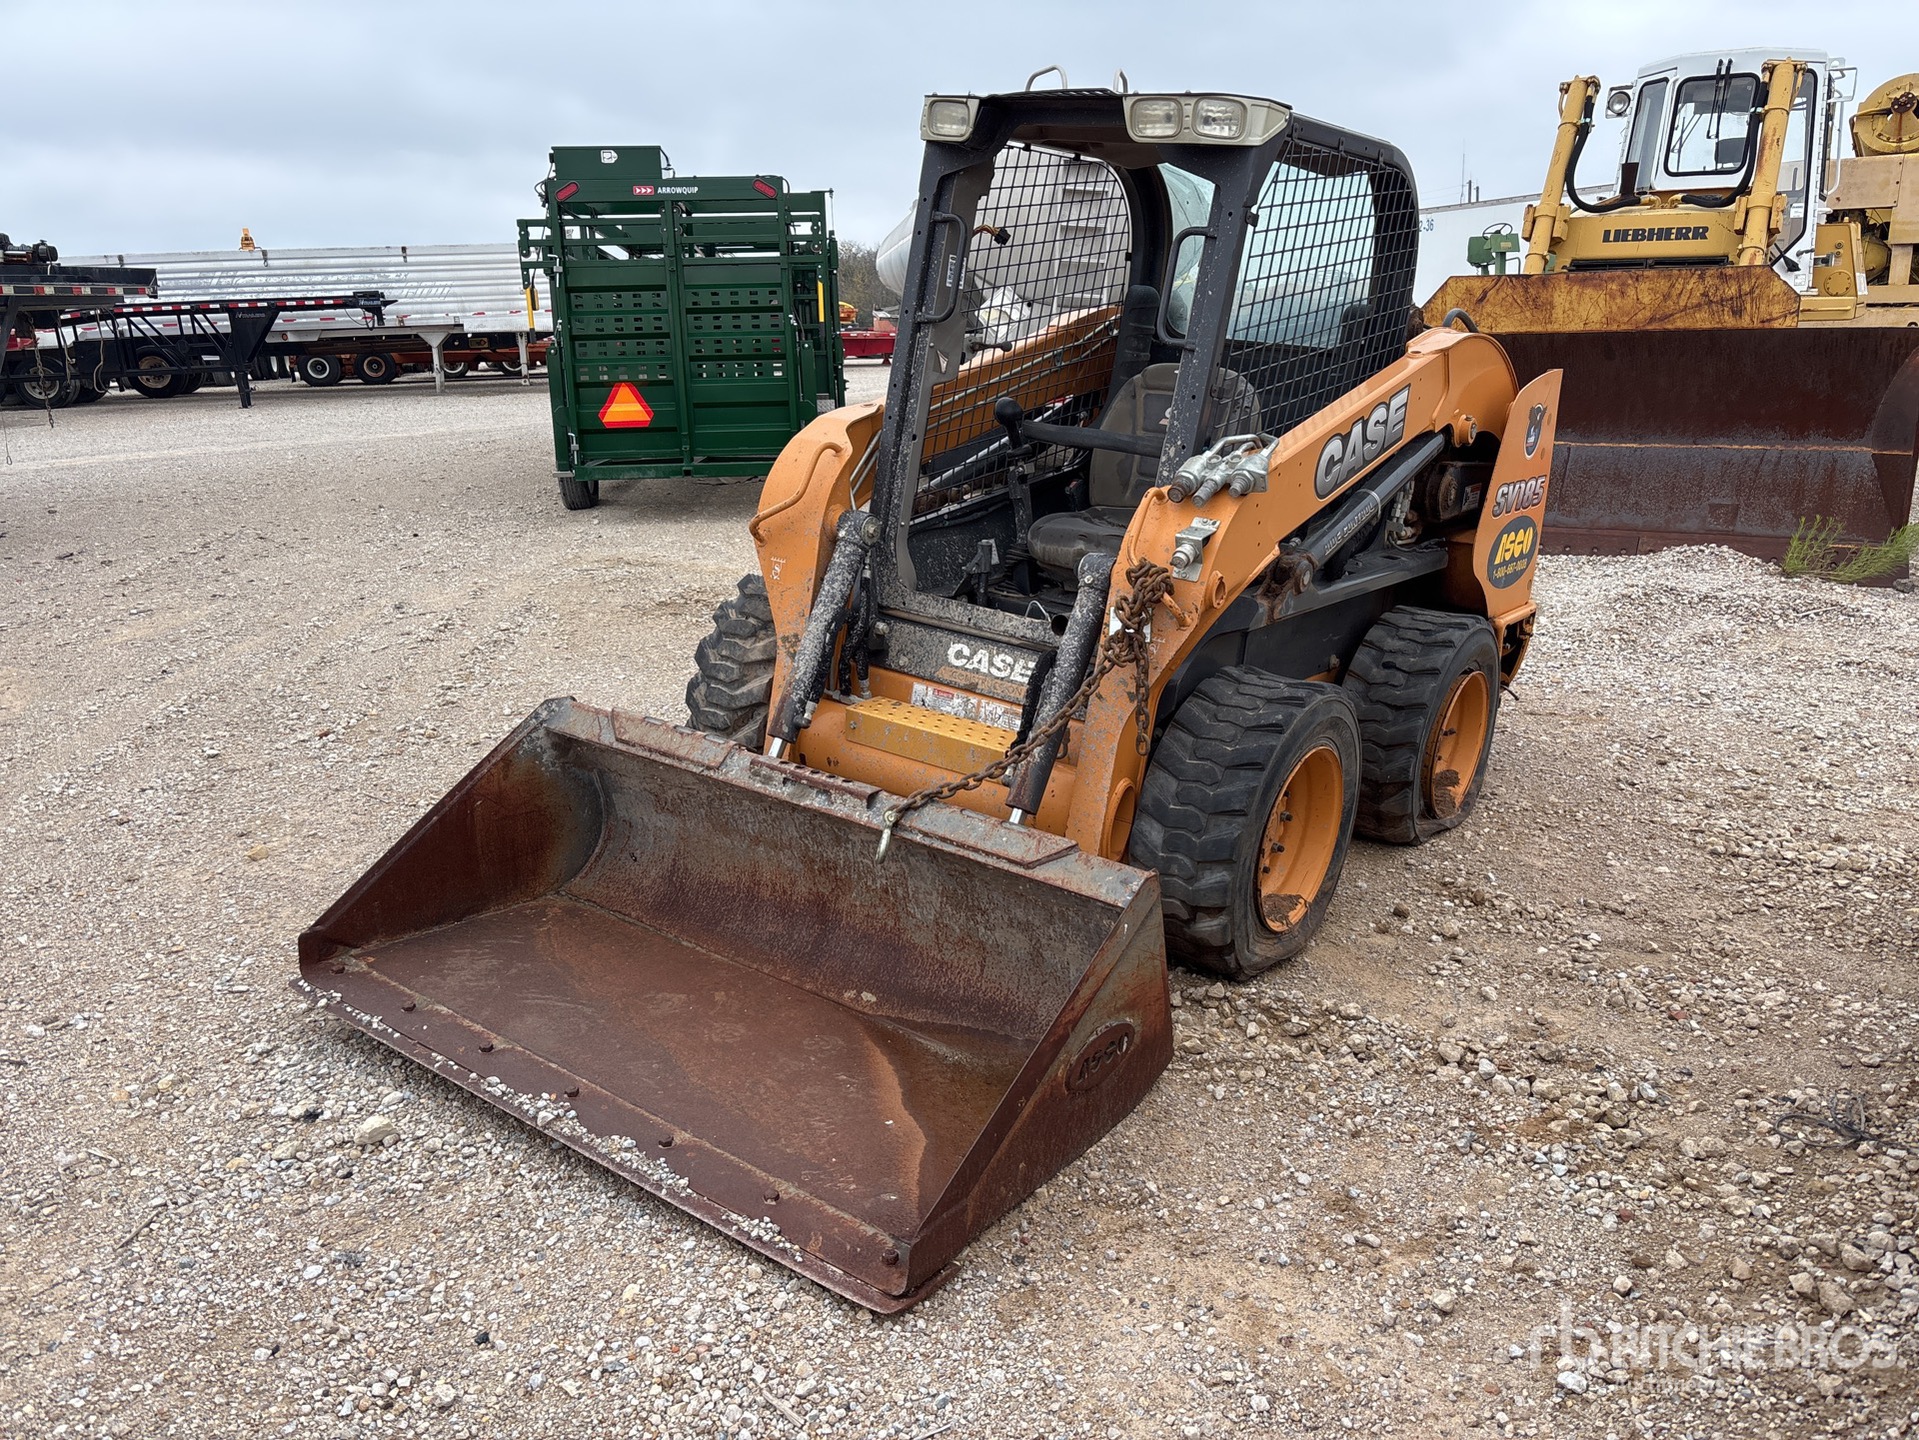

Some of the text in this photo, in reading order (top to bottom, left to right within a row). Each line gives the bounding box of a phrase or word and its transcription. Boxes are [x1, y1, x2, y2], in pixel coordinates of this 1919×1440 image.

[657, 186, 699, 195] ARROWQUIP
[1602, 226, 1709, 243] LIEBHERR
[1314, 383, 1411, 499] CASE
[1492, 475, 1546, 519] SV185
[1494, 526, 1534, 566] ASCO
[946, 641, 1038, 684] CASE
